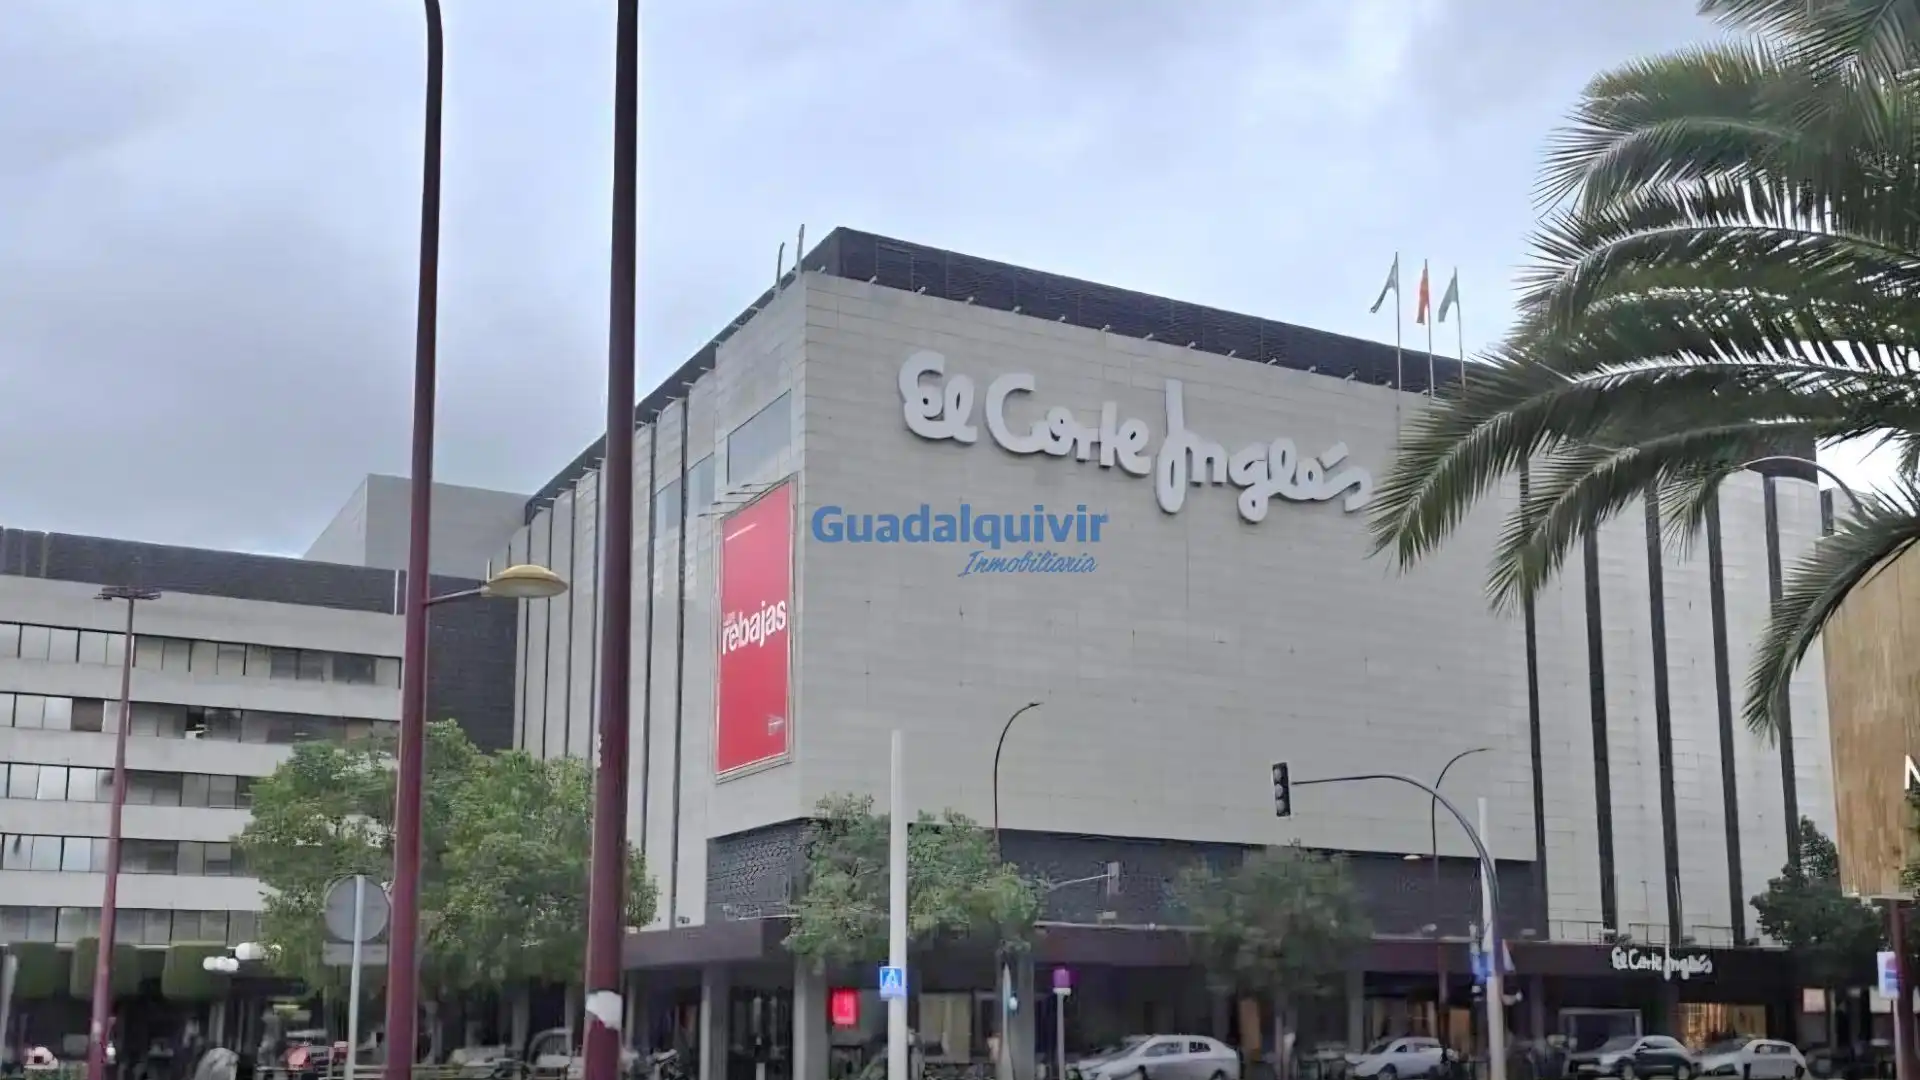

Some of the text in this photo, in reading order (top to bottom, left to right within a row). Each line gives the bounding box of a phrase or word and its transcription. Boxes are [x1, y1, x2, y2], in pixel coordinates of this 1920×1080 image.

[899, 350, 1372, 524] El Corte Inglés
[722, 600, 786, 655] rebajas
